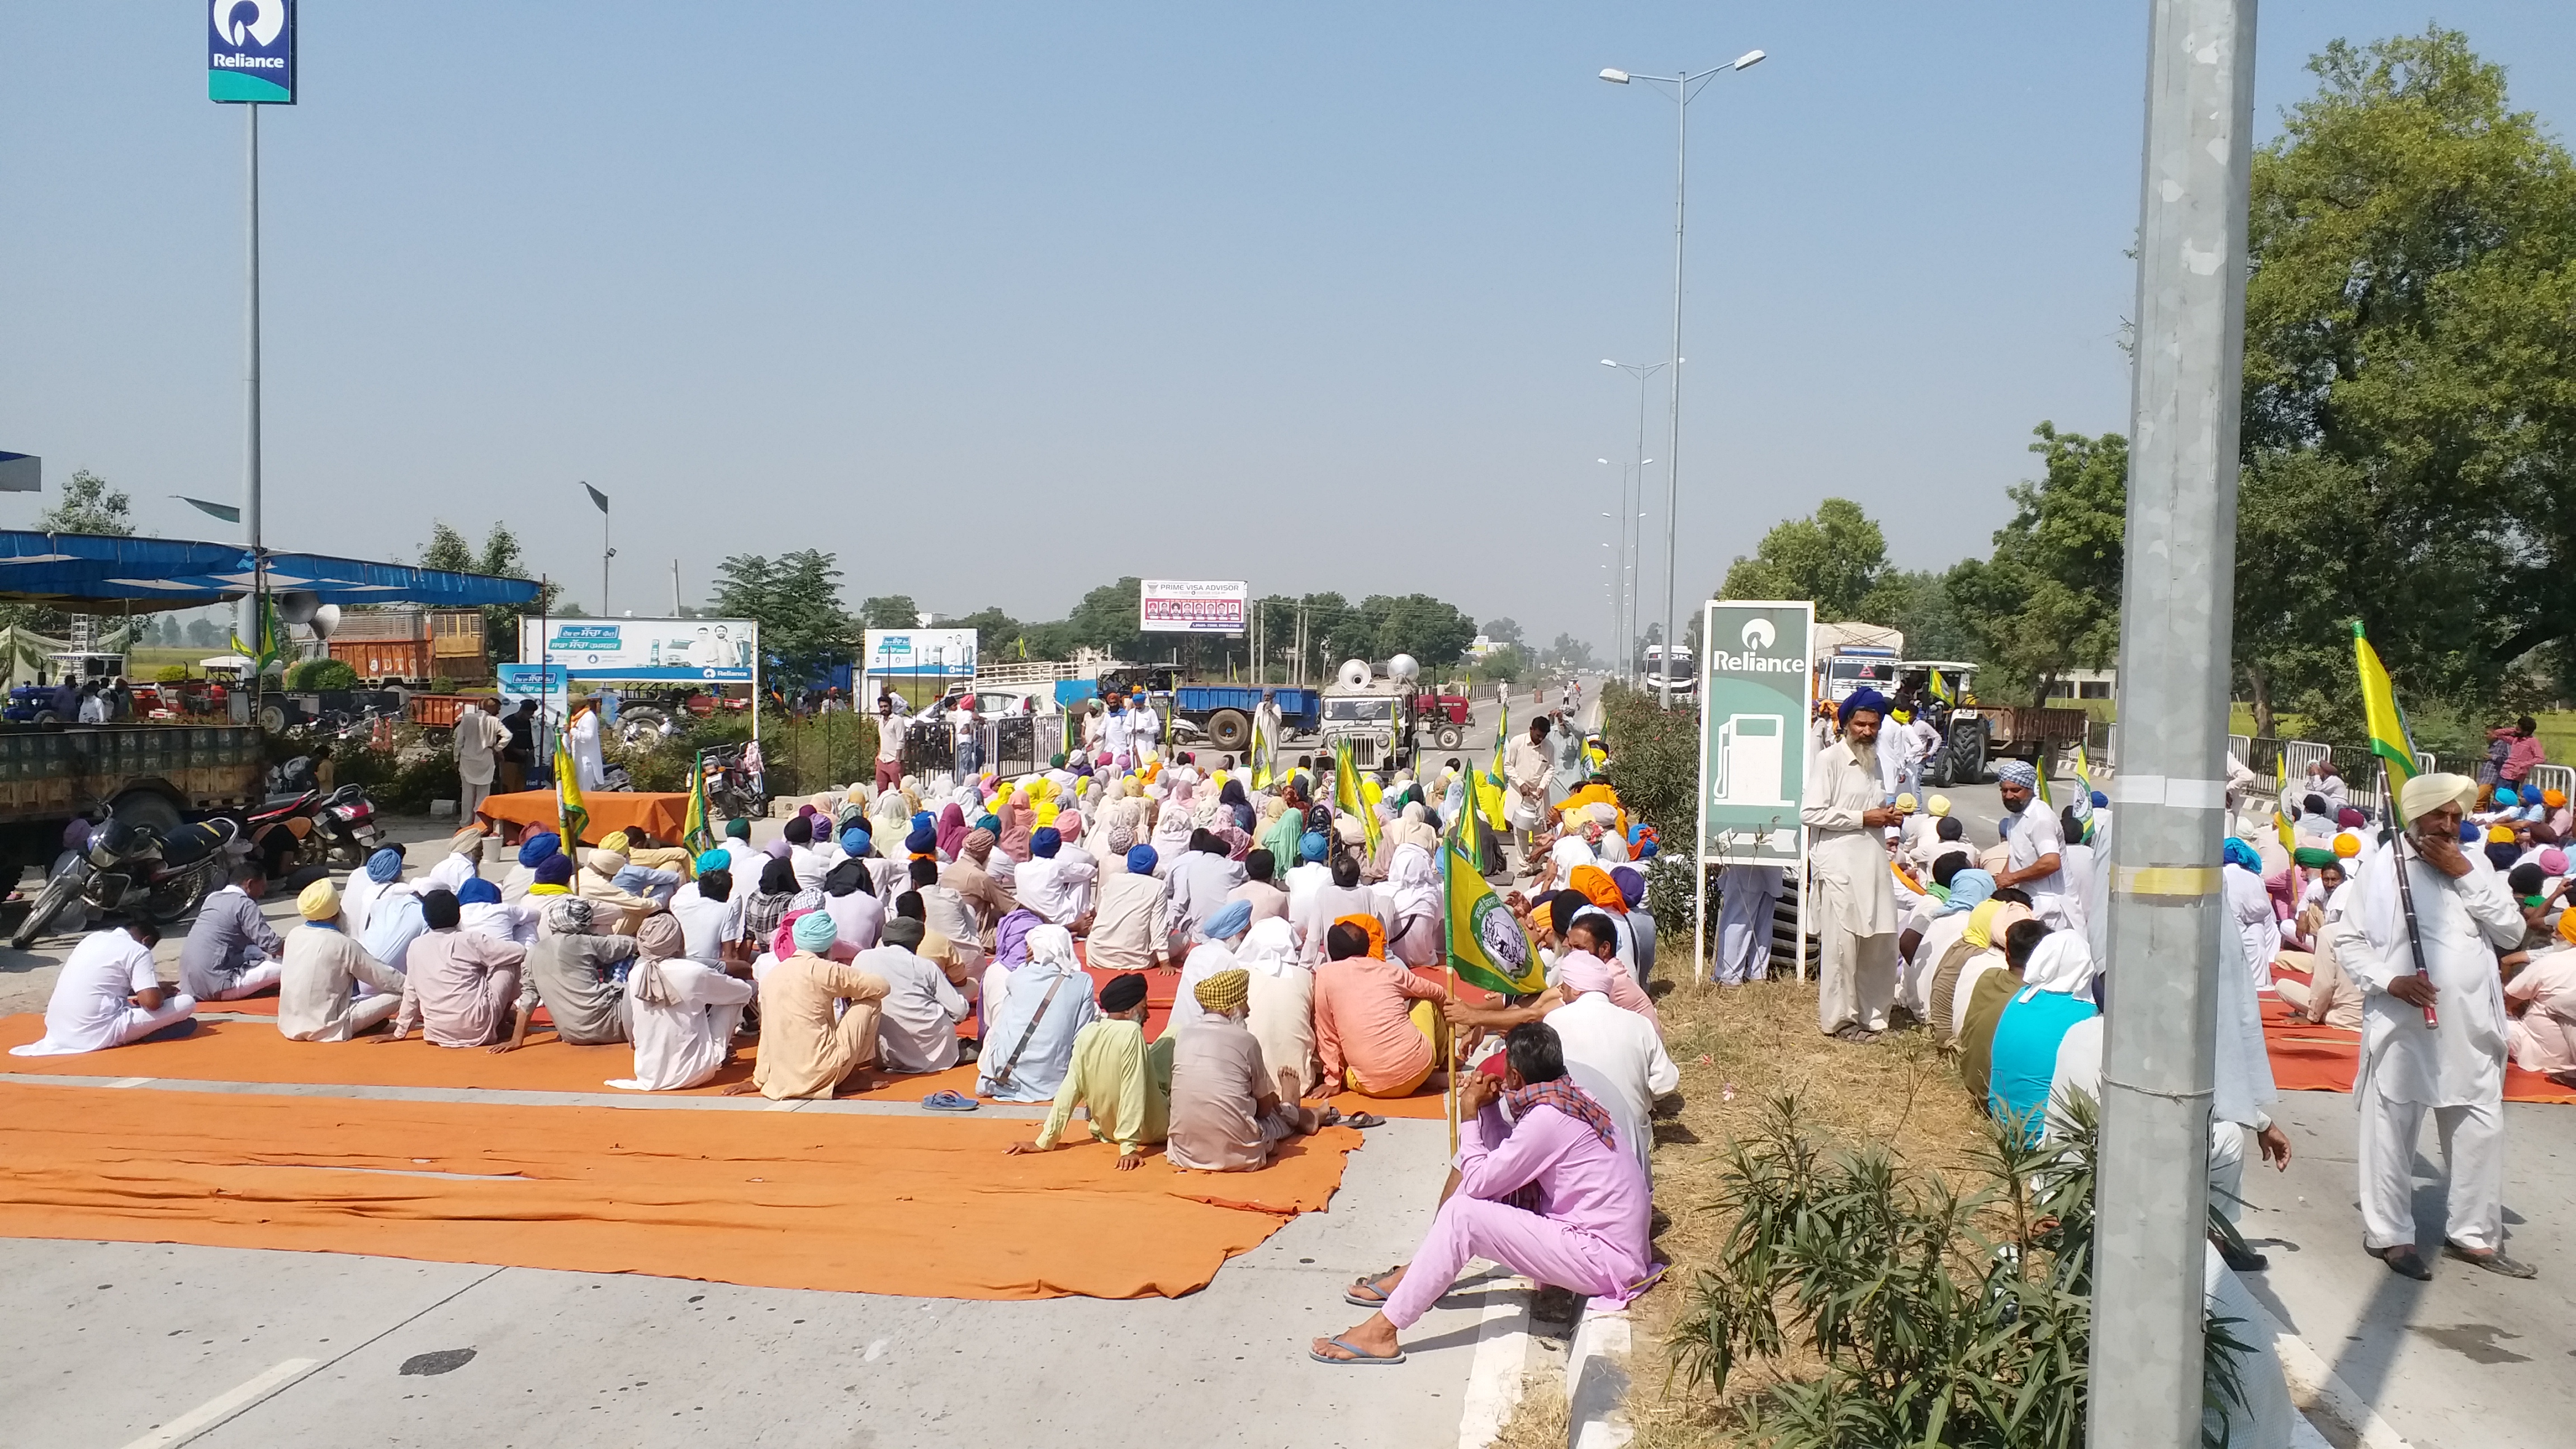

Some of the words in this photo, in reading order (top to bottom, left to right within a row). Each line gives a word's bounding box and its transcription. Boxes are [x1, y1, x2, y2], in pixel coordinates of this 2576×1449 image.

[214, 53, 284, 68] Reliance
[581, 627, 602, 637] ਸੱਚਾ
[569, 640, 589, 648] ਸੱਚਾ
[1713, 650, 1805, 673] Reliance
